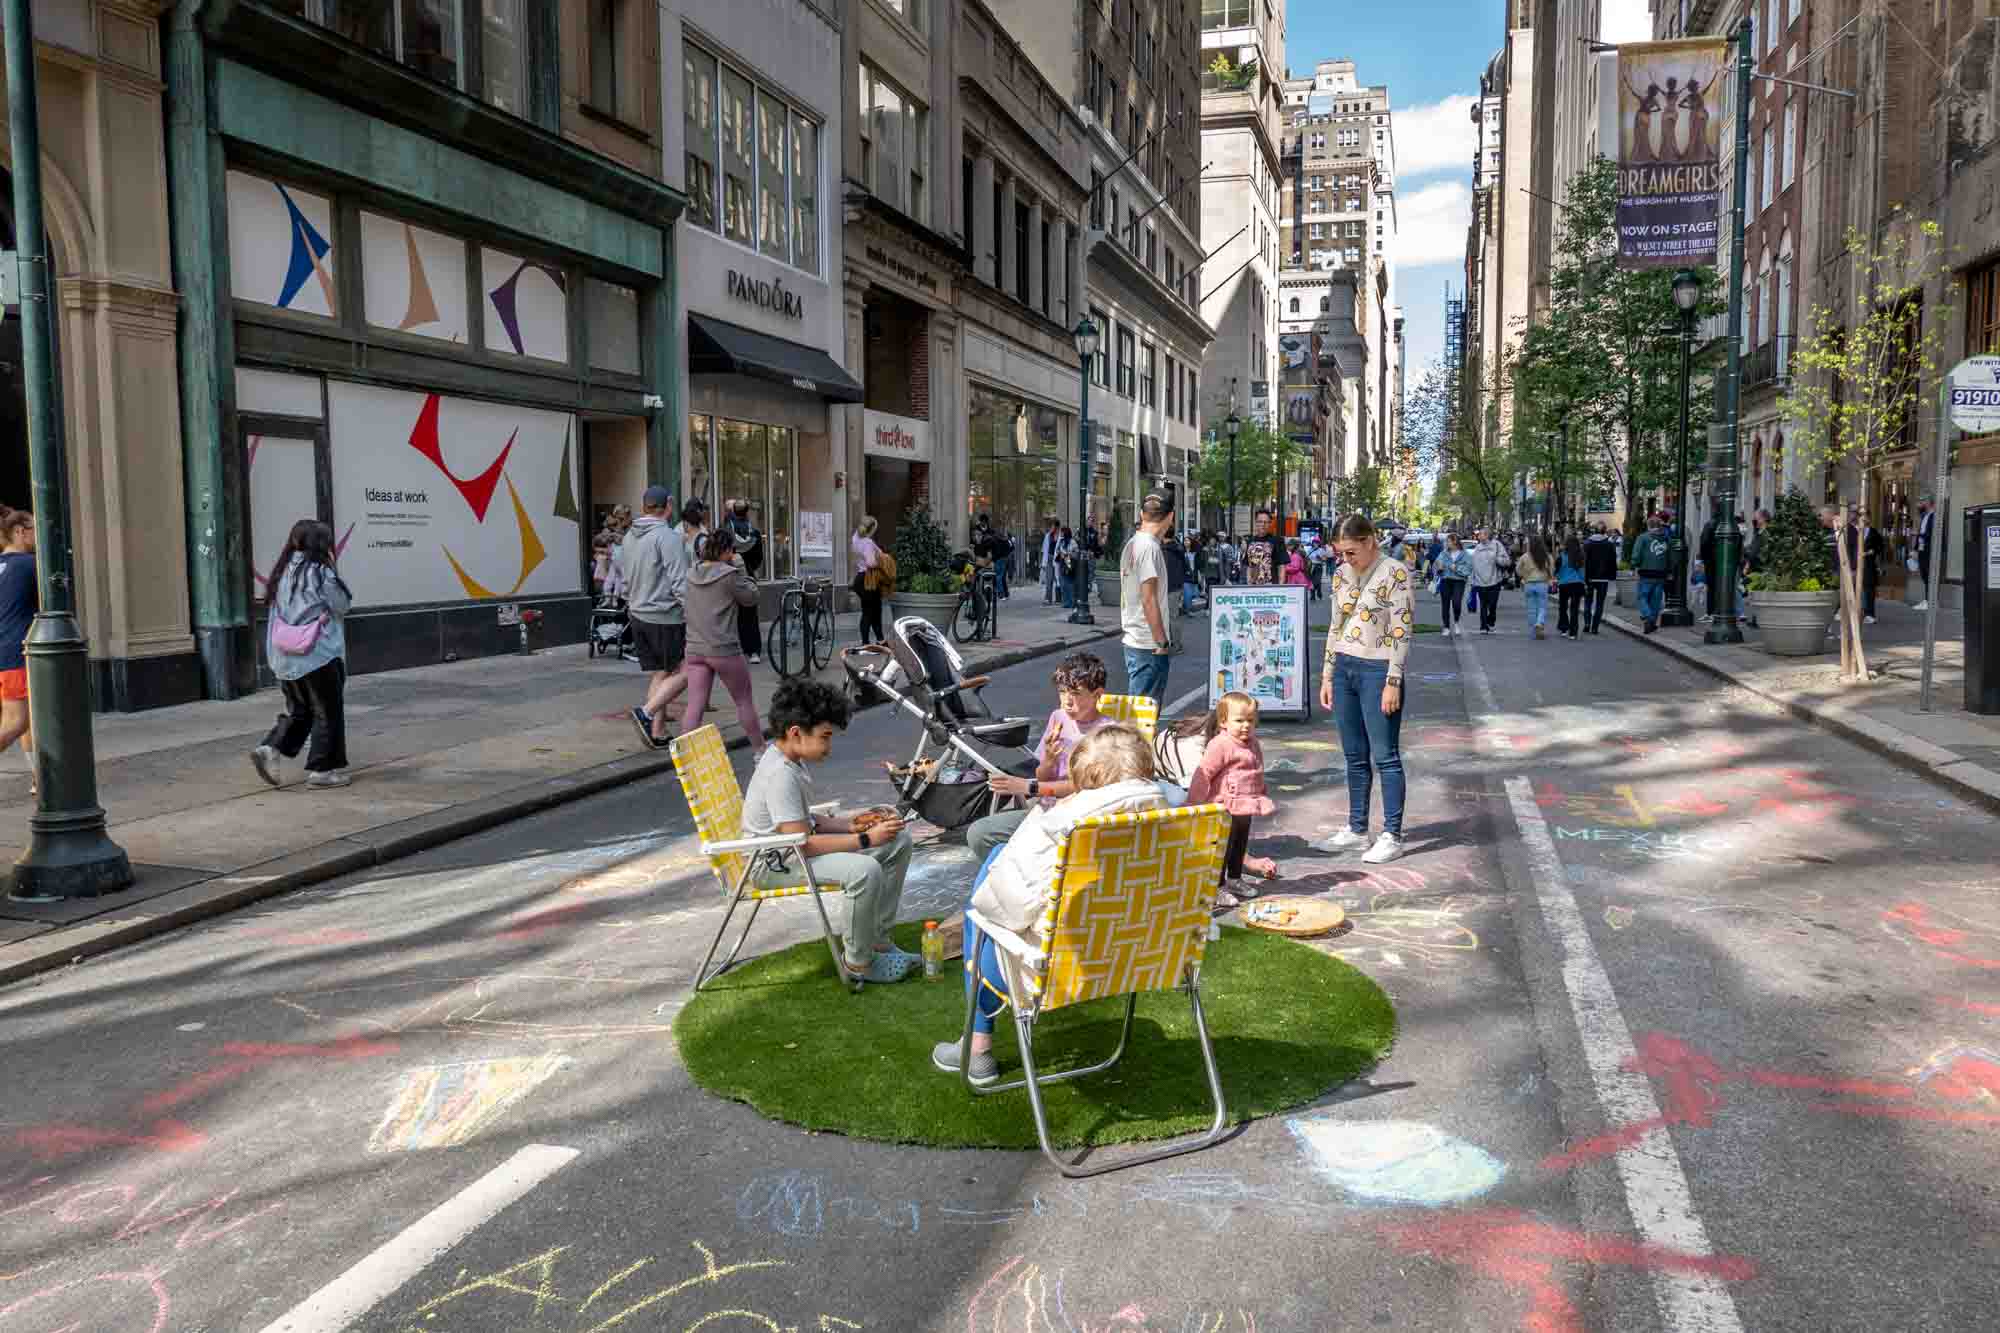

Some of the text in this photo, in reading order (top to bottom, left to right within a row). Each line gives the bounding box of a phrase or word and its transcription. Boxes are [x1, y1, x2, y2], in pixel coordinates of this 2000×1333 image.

[1618, 164, 1719, 194] DREAMGIRLS
[1620, 222, 1717, 236] NOW ON STAGE!
[365, 487, 429, 504] Ideas at work
[1216, 595, 1243, 605] OPEN
[1245, 595, 1287, 604] STREETS
